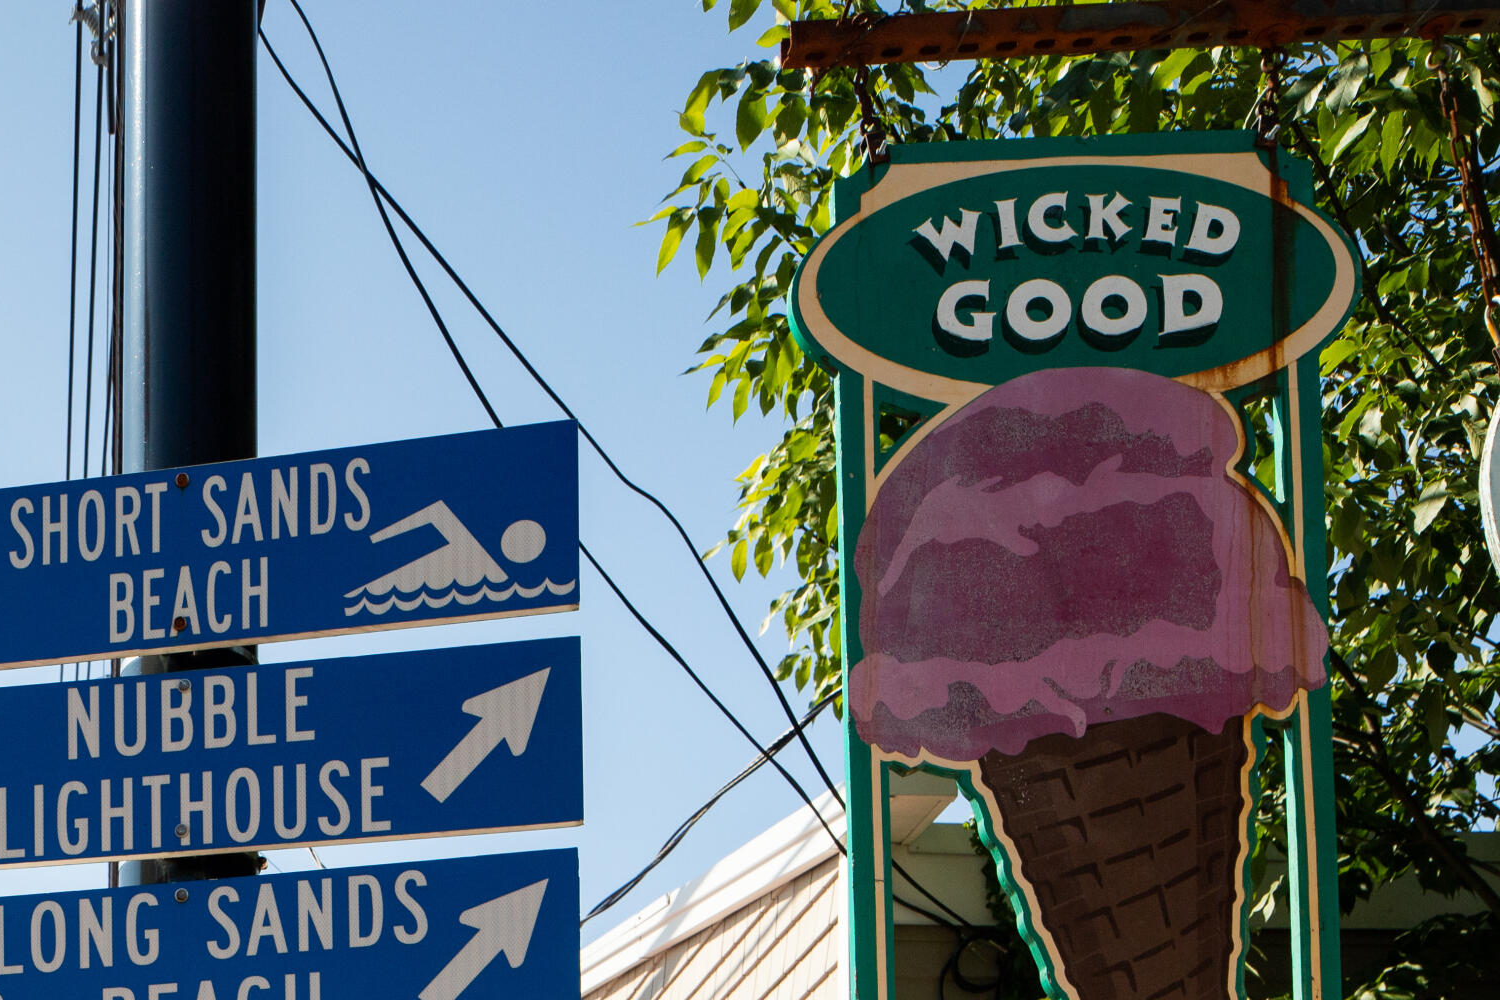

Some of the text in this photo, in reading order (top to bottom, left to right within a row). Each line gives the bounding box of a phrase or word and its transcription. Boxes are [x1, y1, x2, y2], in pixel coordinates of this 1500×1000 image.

[911, 190, 1241, 263] WICKED
[935, 273, 1224, 342] GOOD
[8, 457, 372, 570] SHORT SANDS
[108, 556, 270, 644] BEACH
[66, 666, 316, 760] NUBBLE
[206, 869, 430, 961] SANDS
